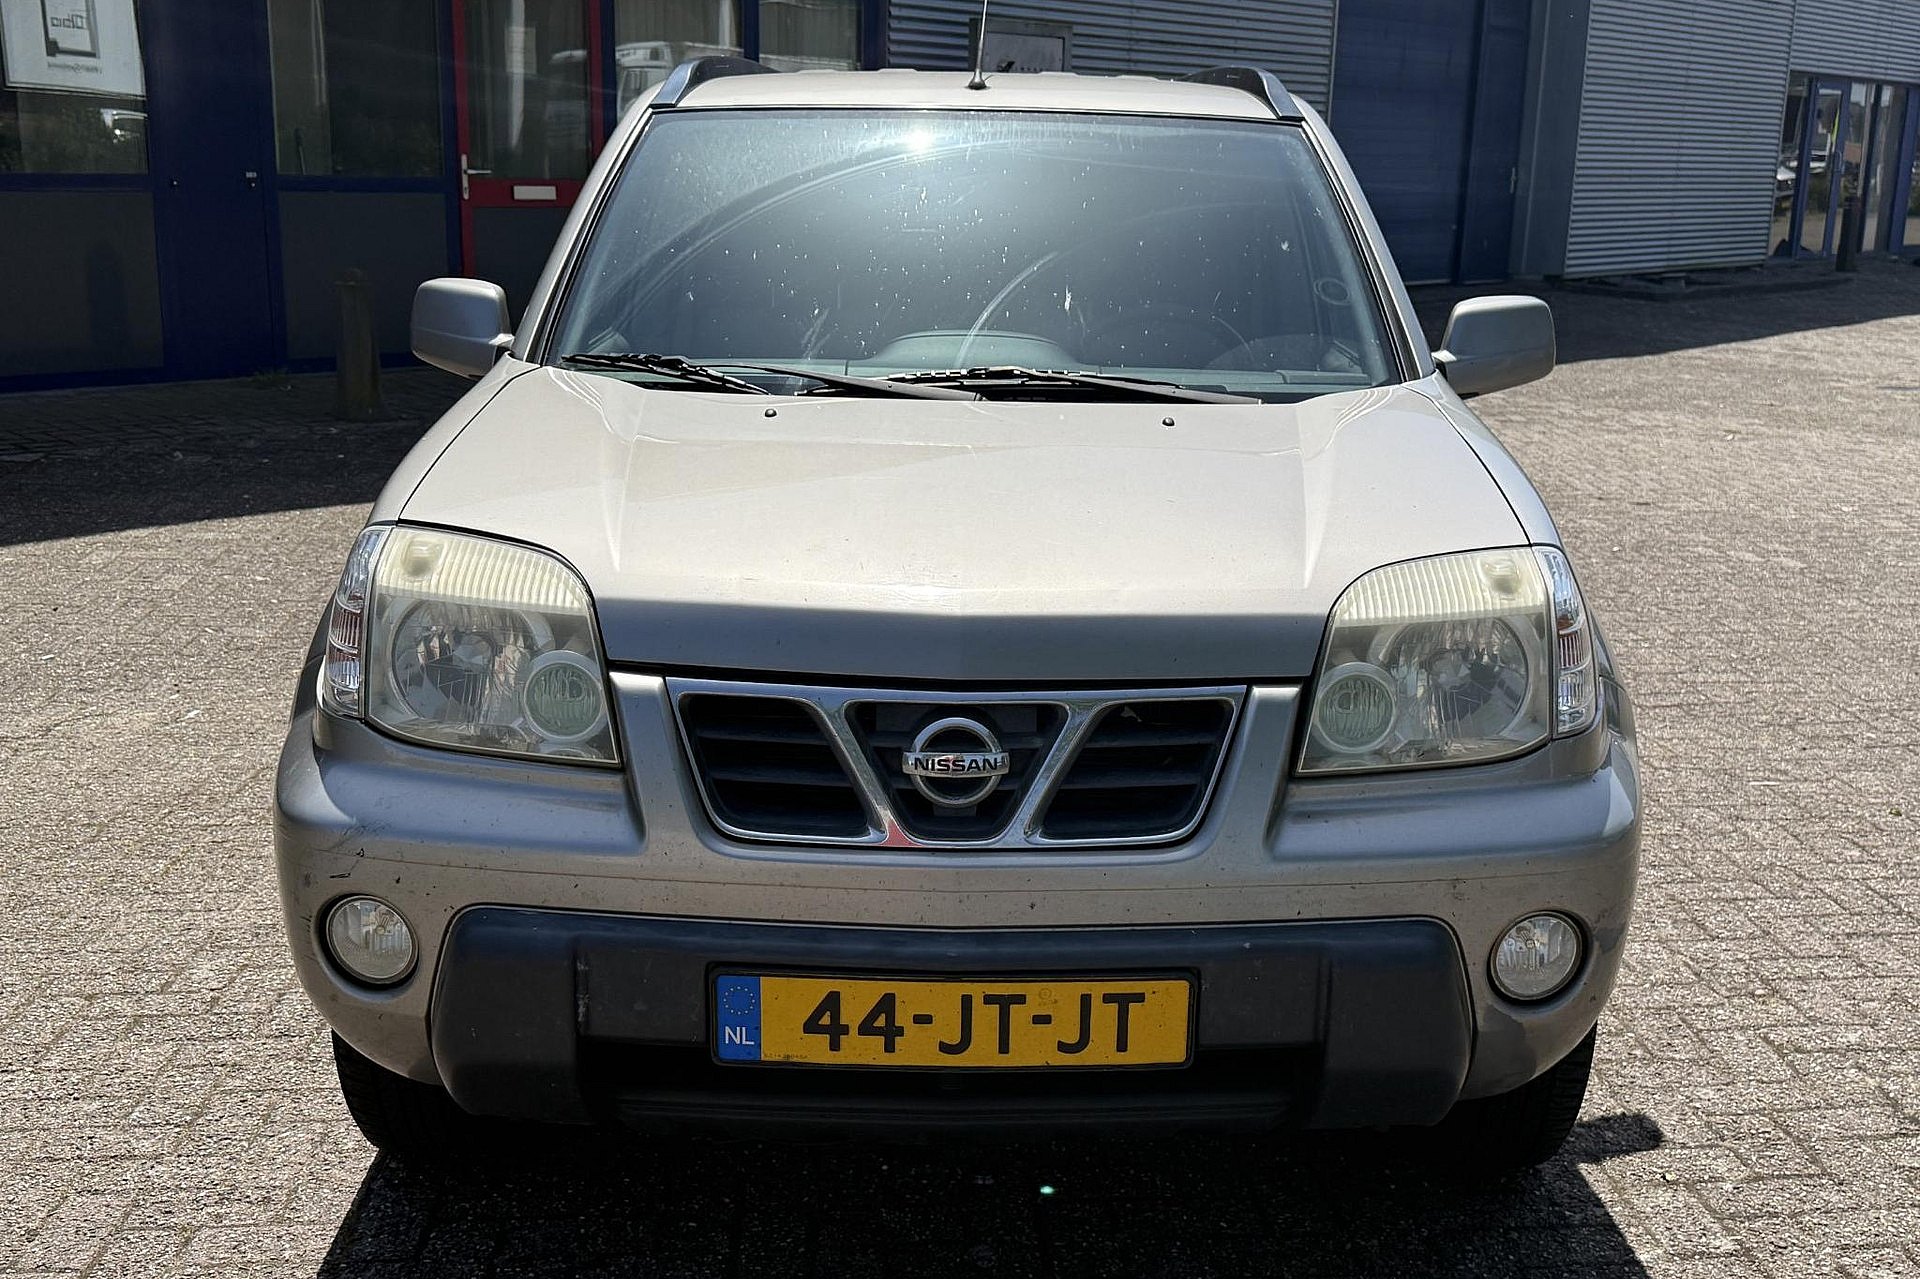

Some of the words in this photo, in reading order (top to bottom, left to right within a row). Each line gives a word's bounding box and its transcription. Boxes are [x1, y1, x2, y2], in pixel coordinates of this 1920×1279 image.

[914, 757, 998, 771] NISSAN
[802, 990, 1146, 1055] 44-JT-JT
[724, 1026, 755, 1045] NL
